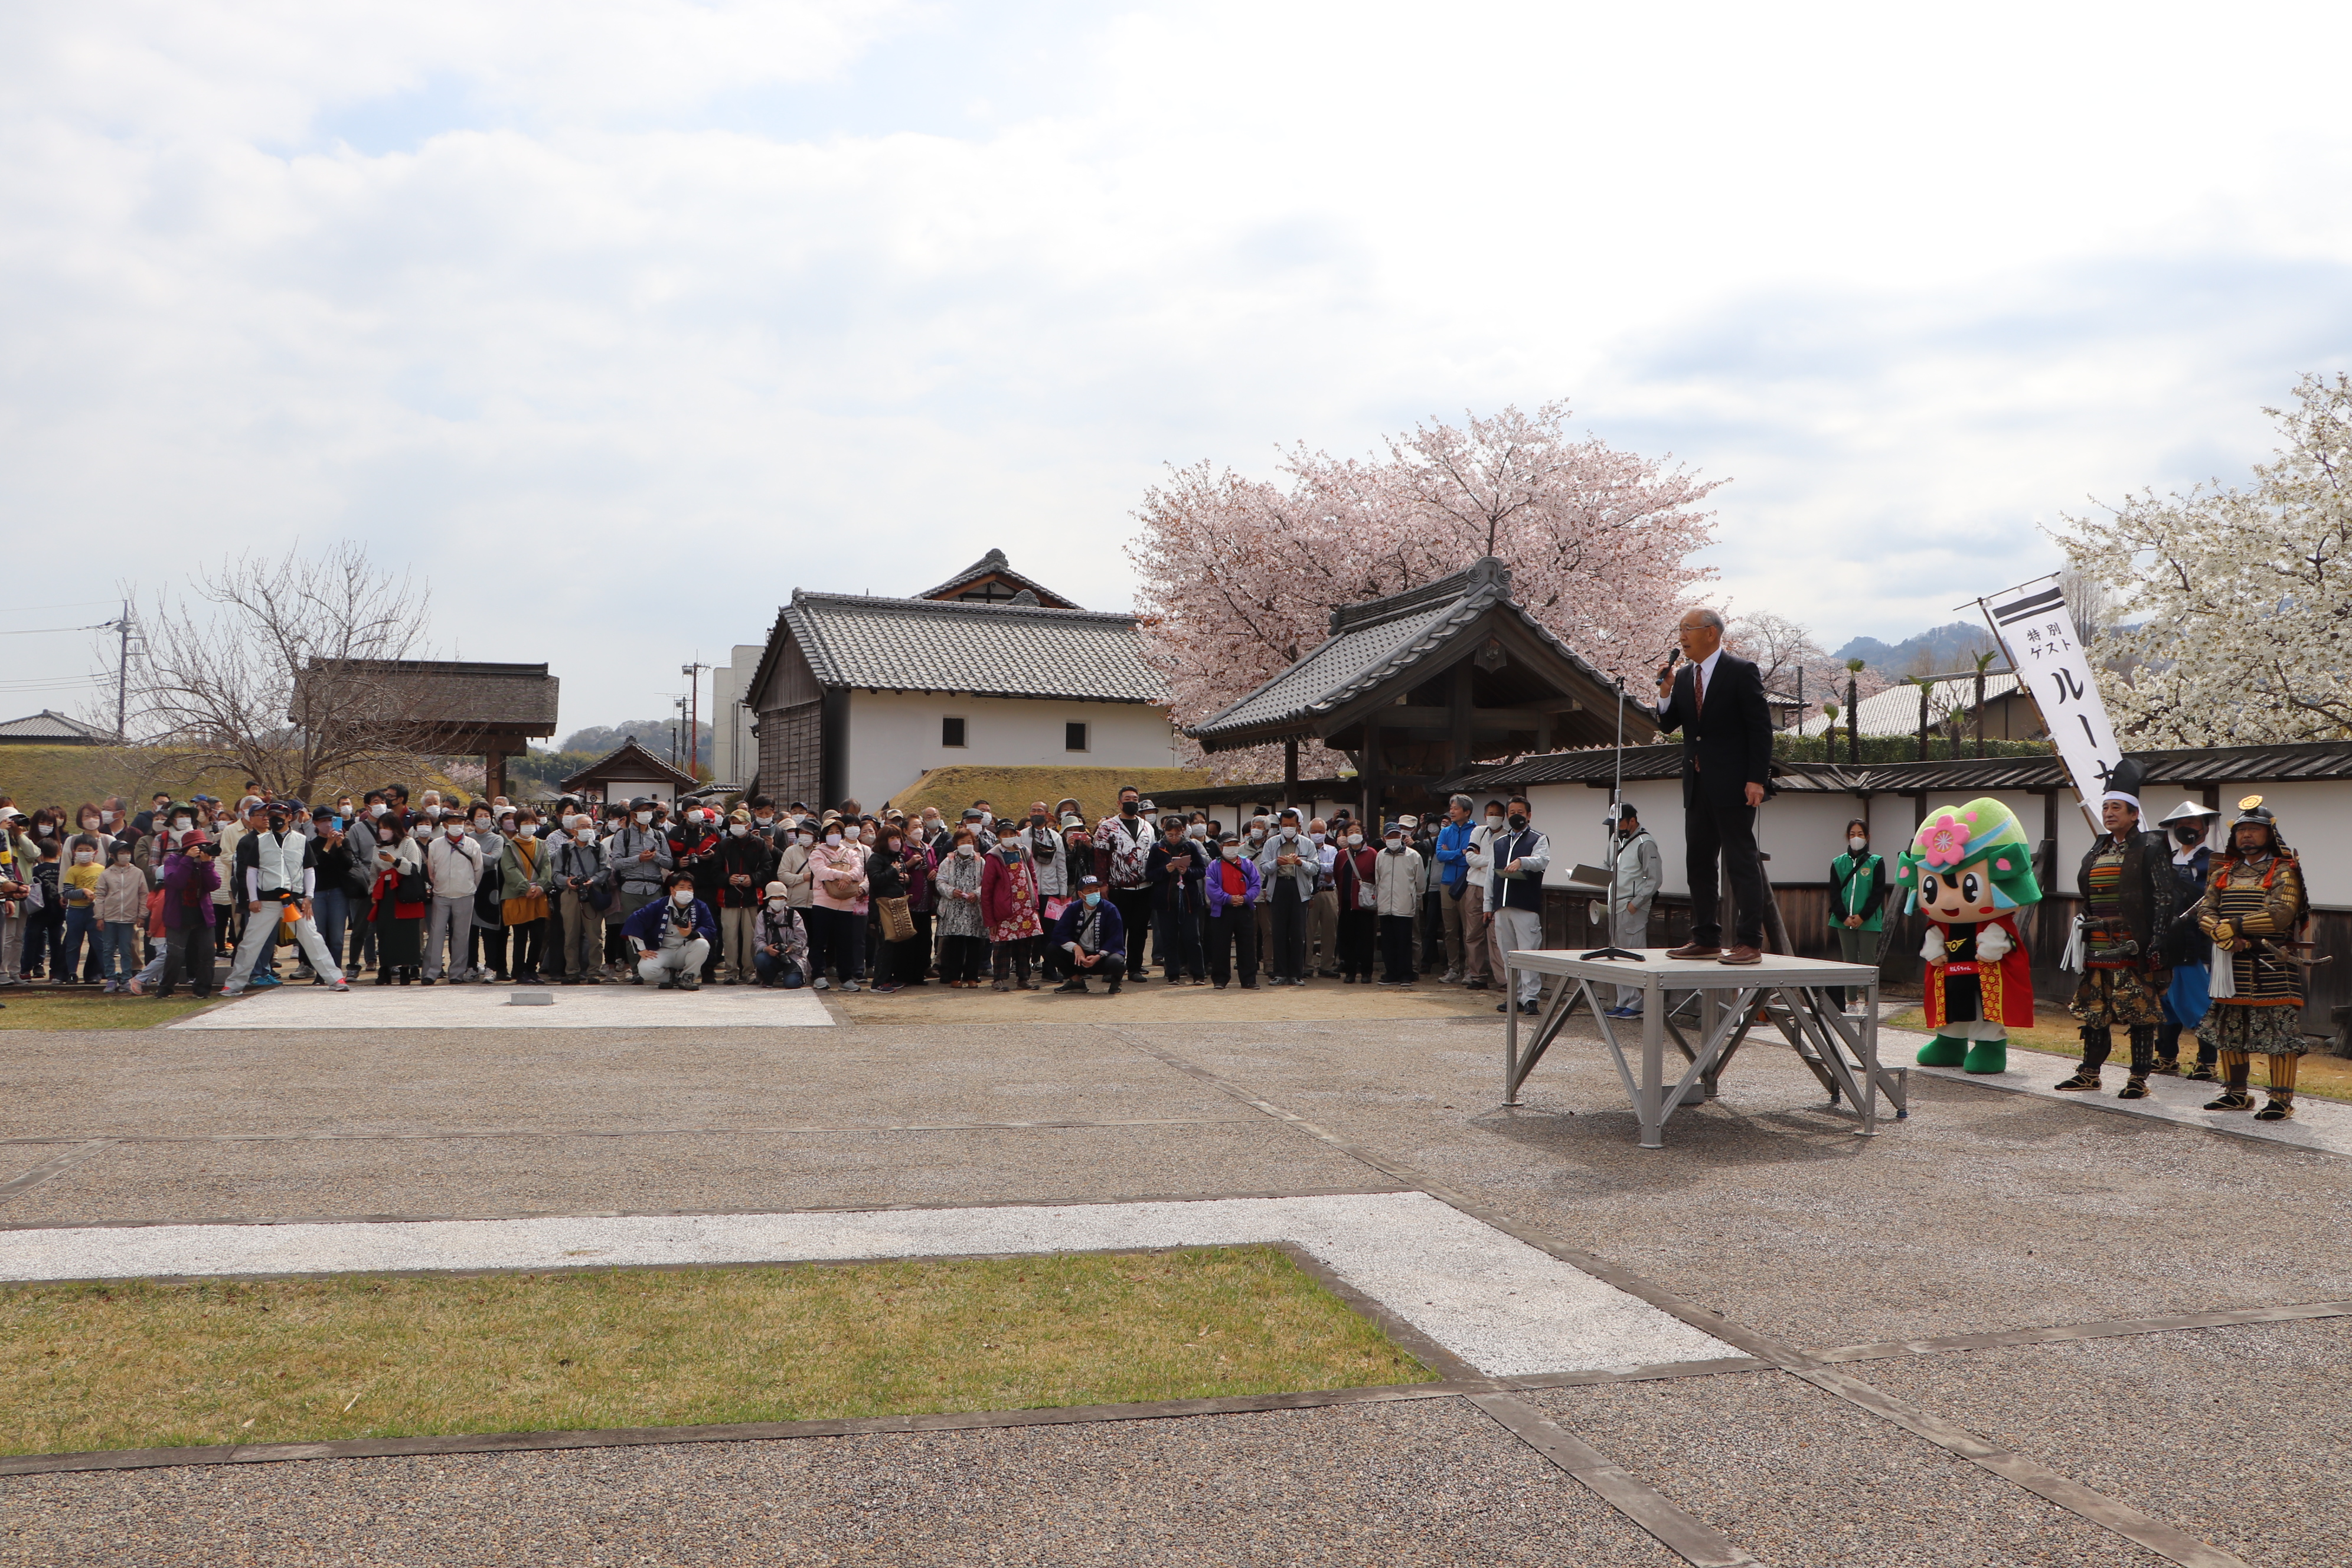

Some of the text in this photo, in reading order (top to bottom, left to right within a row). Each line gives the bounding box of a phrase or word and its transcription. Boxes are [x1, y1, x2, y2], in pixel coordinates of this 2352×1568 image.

[2027, 622, 2062, 643] 特別
[2030, 639, 2071, 660] ゲスト
